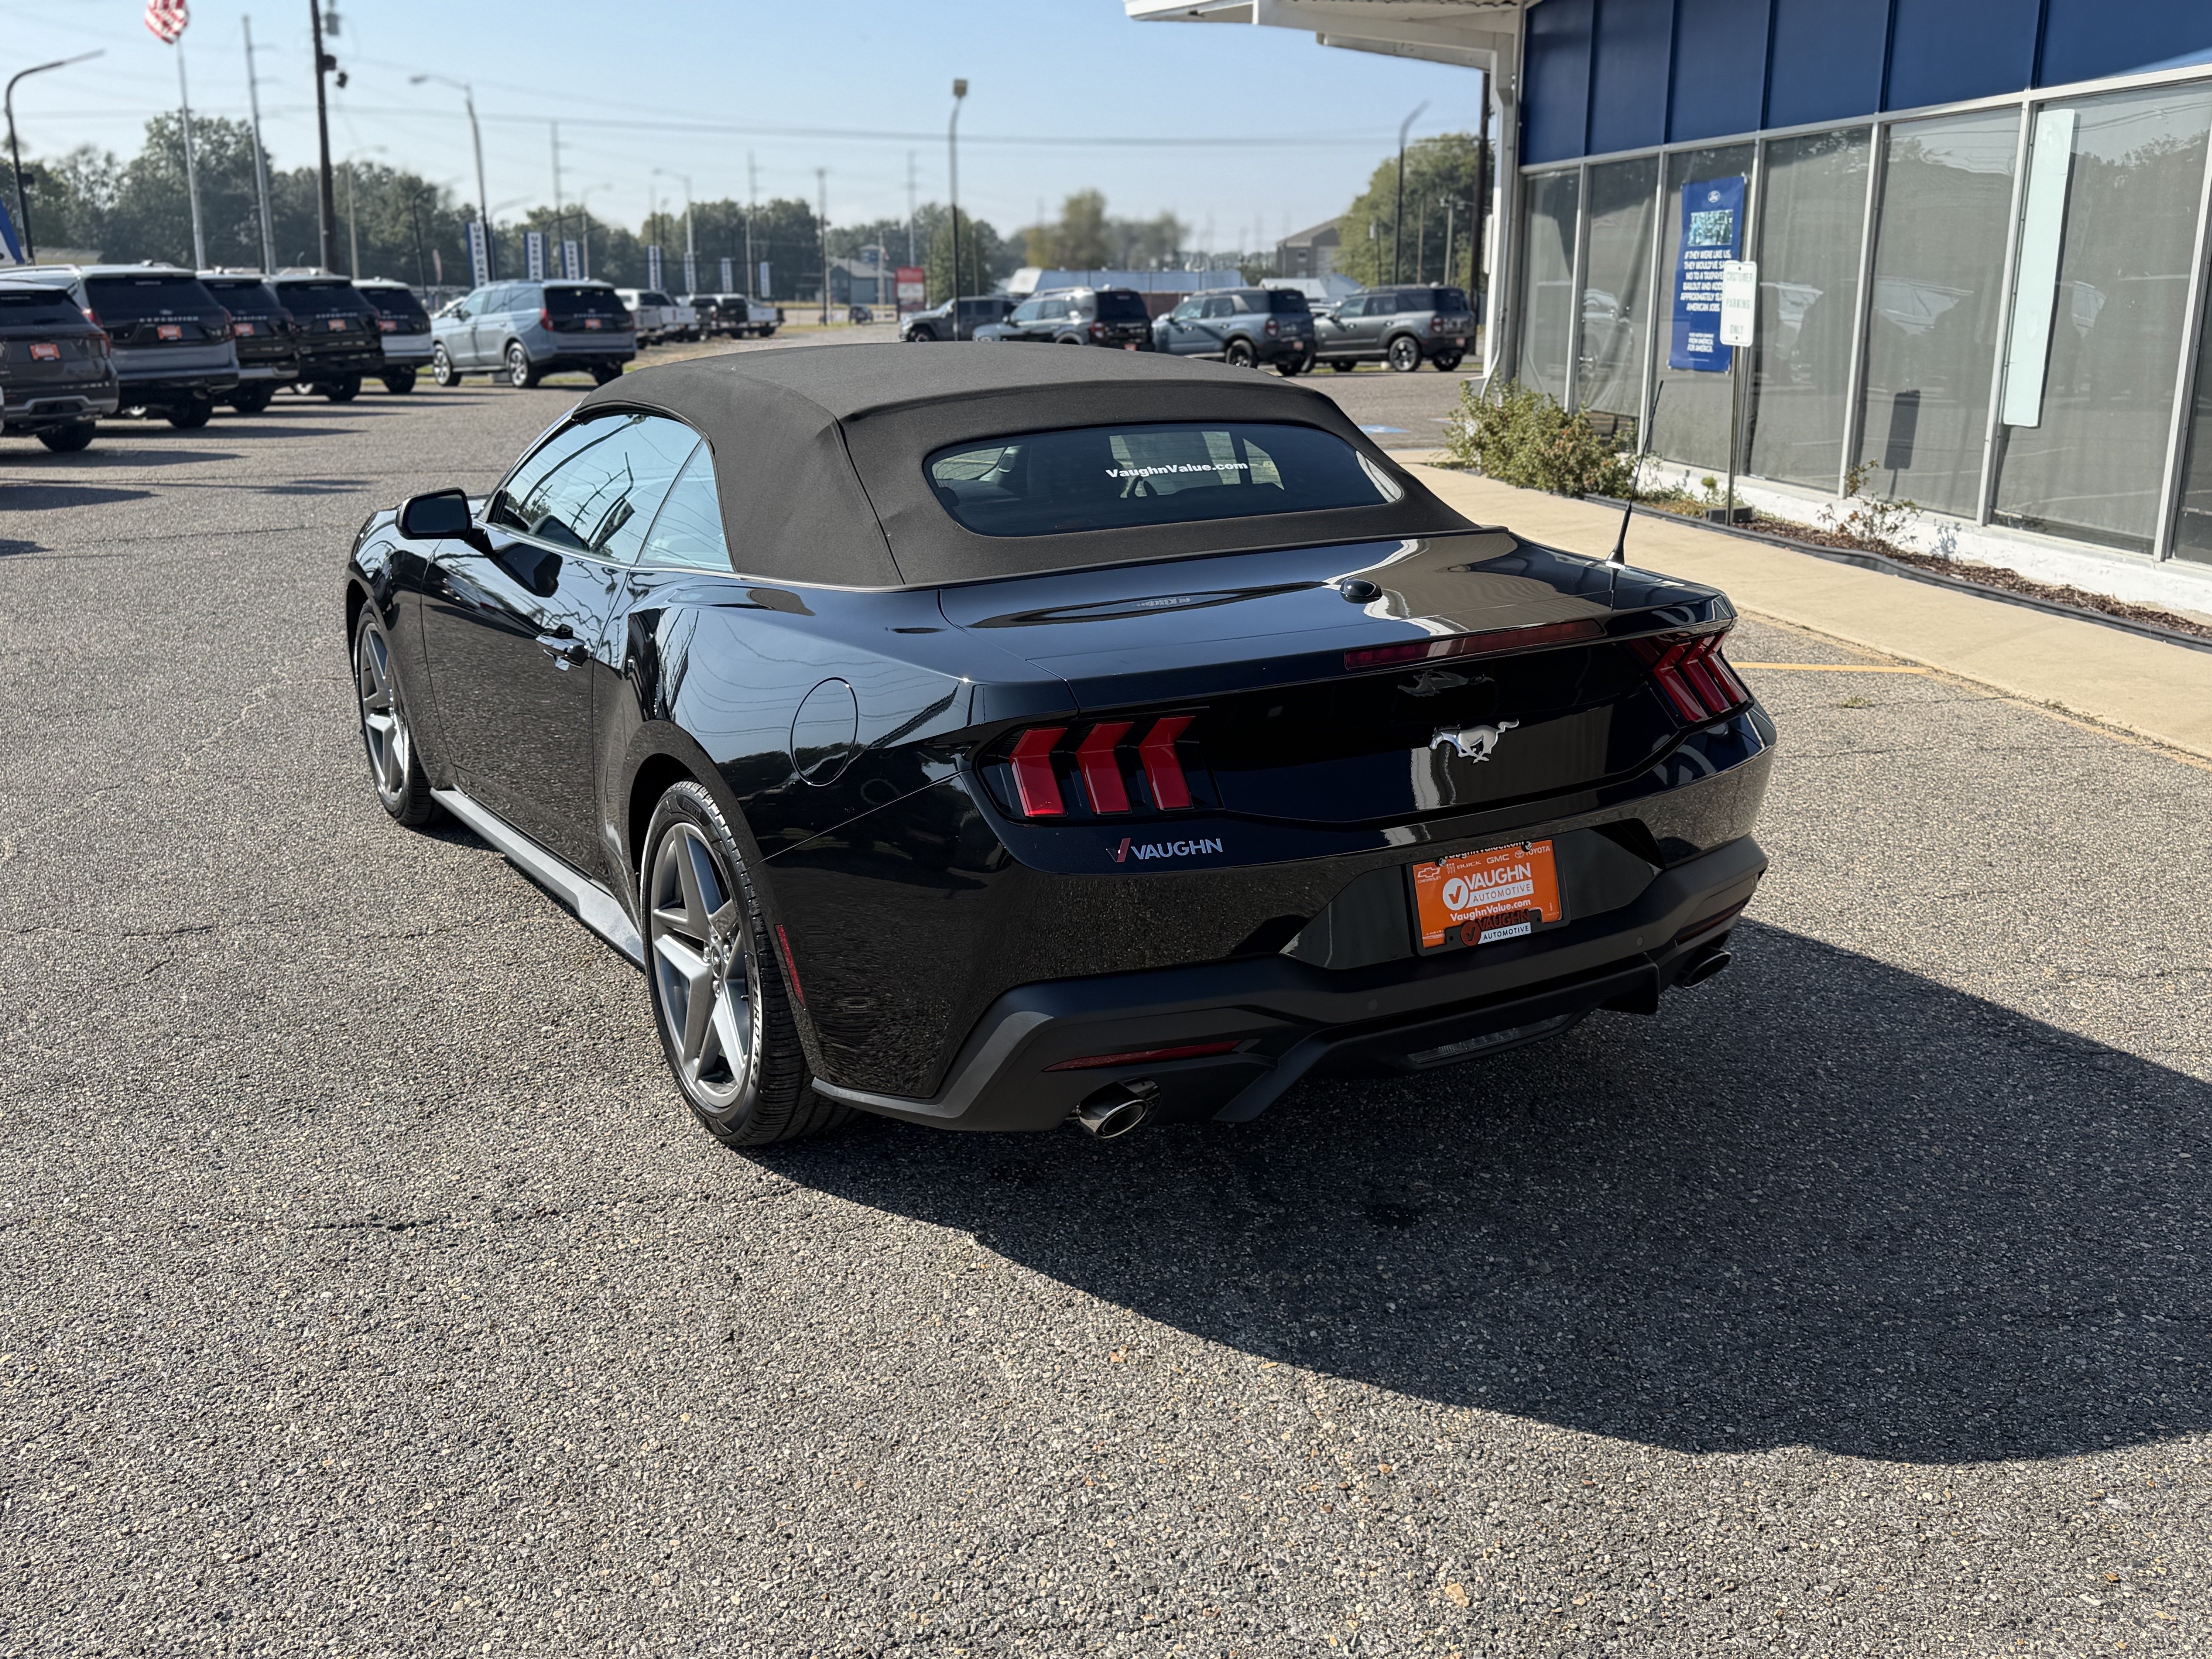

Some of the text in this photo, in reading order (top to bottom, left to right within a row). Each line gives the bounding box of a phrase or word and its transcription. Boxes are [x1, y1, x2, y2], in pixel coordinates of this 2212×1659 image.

[1727, 272, 1752, 282] CUSTOMER
[1726, 298, 1750, 309] PARKING
[1730, 324, 1743, 335] ONLY
[1106, 463, 1248, 477] VaughnValue.com
[1130, 838, 1223, 860] VAUGHN
[1456, 860, 1482, 870] BUICK
[1486, 854, 1510, 864] GMC
[1464, 862, 1532, 890] VAUGHN
[1473, 883, 1531, 903] AUTOMOTIVE
[1450, 898, 1531, 922] VaughnValue.com
[1478, 908, 1530, 931] VAUGHN
[1483, 925, 1529, 941] AUTOMOTIVE
